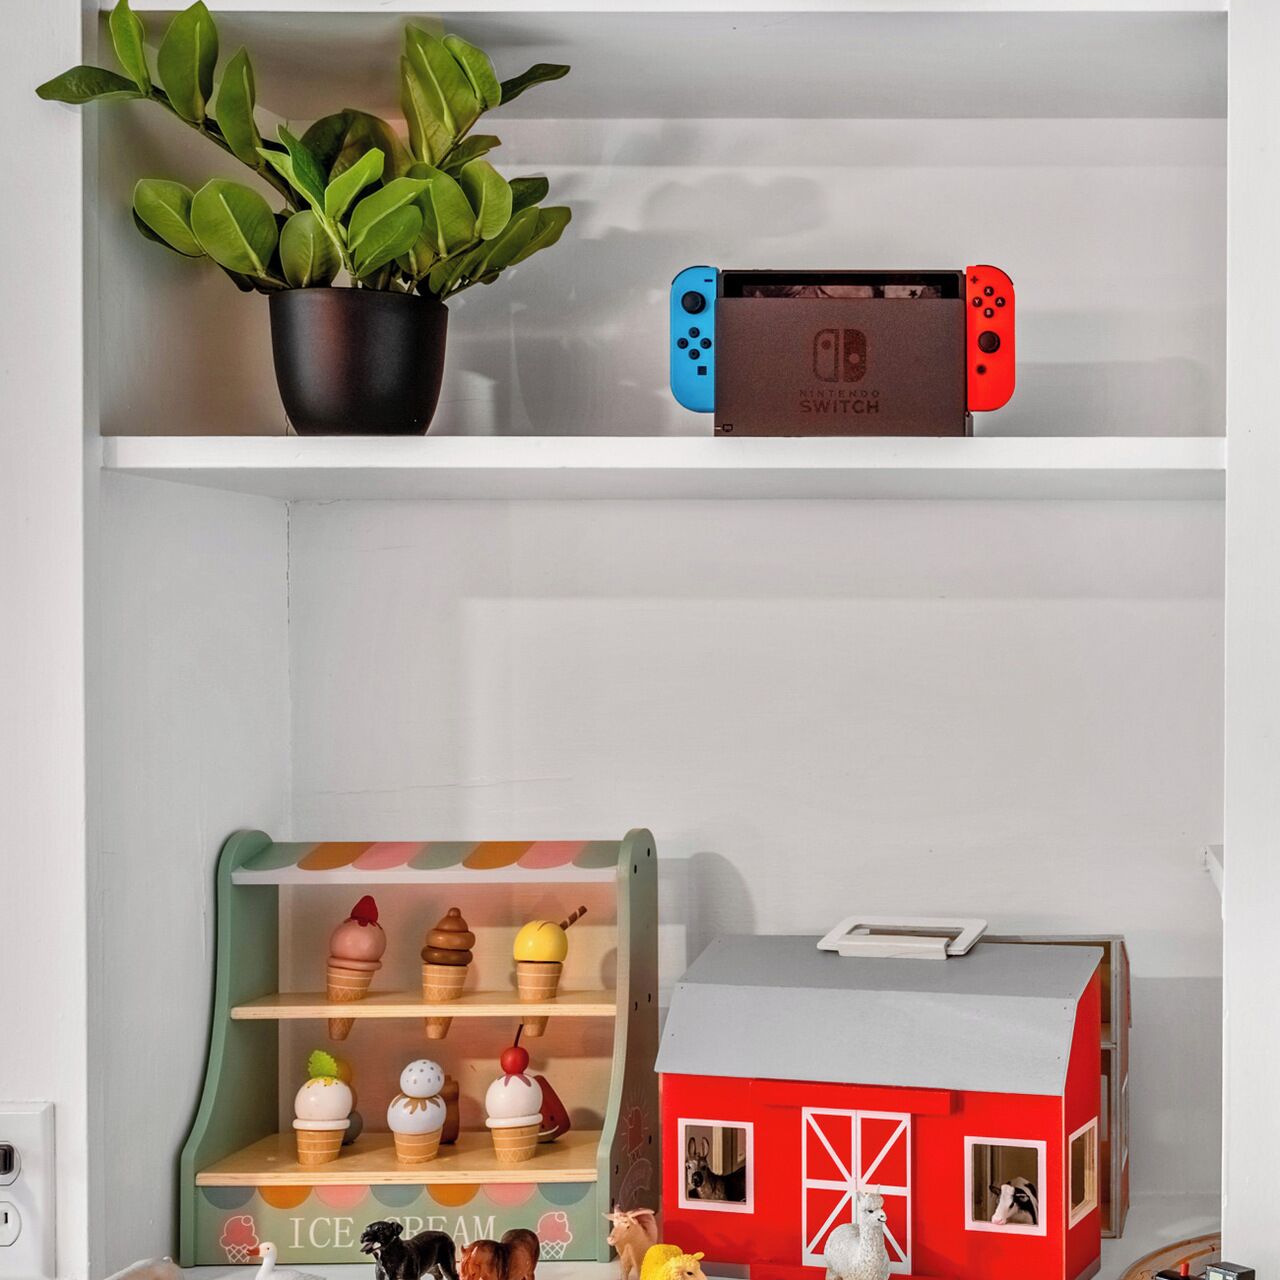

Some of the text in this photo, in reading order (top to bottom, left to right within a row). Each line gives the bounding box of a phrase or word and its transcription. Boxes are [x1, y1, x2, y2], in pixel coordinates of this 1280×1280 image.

[800, 390, 881, 398] NINTENDO
[799, 400, 880, 414] SWITCH
[288, 1217, 354, 1249] ICE
